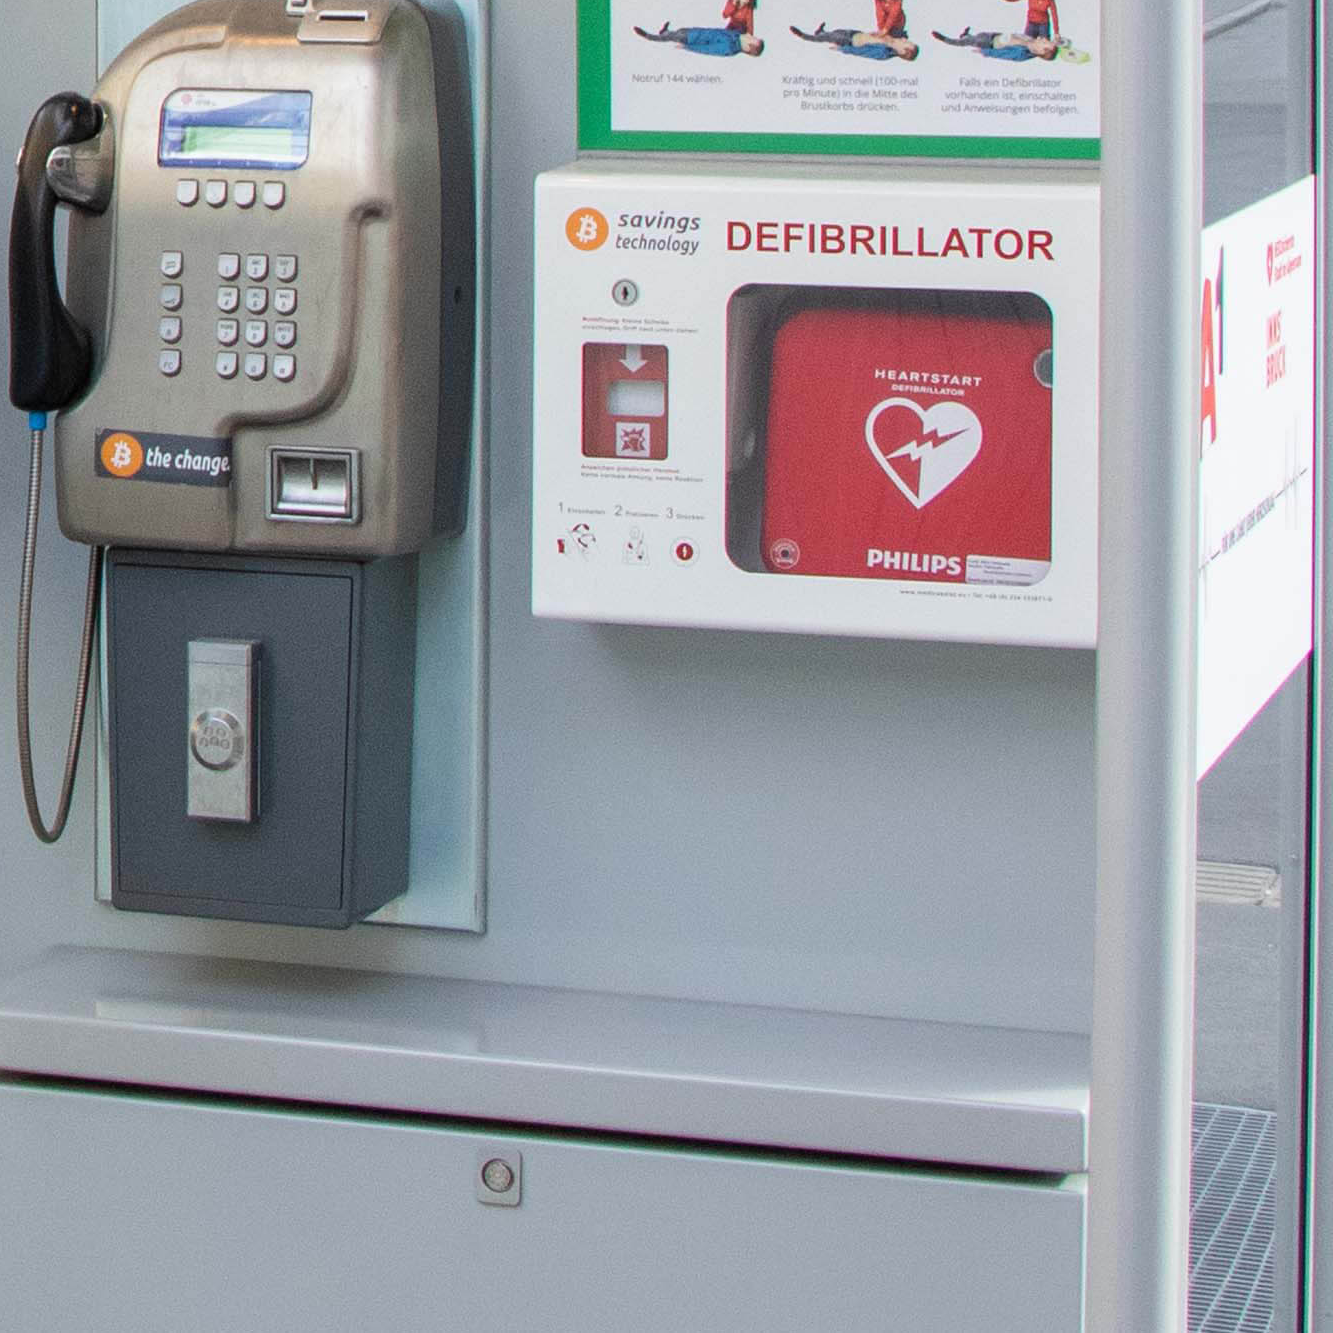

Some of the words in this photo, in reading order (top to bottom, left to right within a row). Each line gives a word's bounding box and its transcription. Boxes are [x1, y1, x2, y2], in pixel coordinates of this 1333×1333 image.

[617, 211, 701, 234] savings
[615, 234, 700, 256] technology
[726, 221, 1056, 261] DEFIBRILLATOR
[874, 369, 983, 387] HEARTSTART
[891, 383, 965, 396] DEFIBRILLATOR
[145, 446, 172, 469] the
[174, 448, 230, 476] change.
[866, 548, 962, 576] PHILIPS
